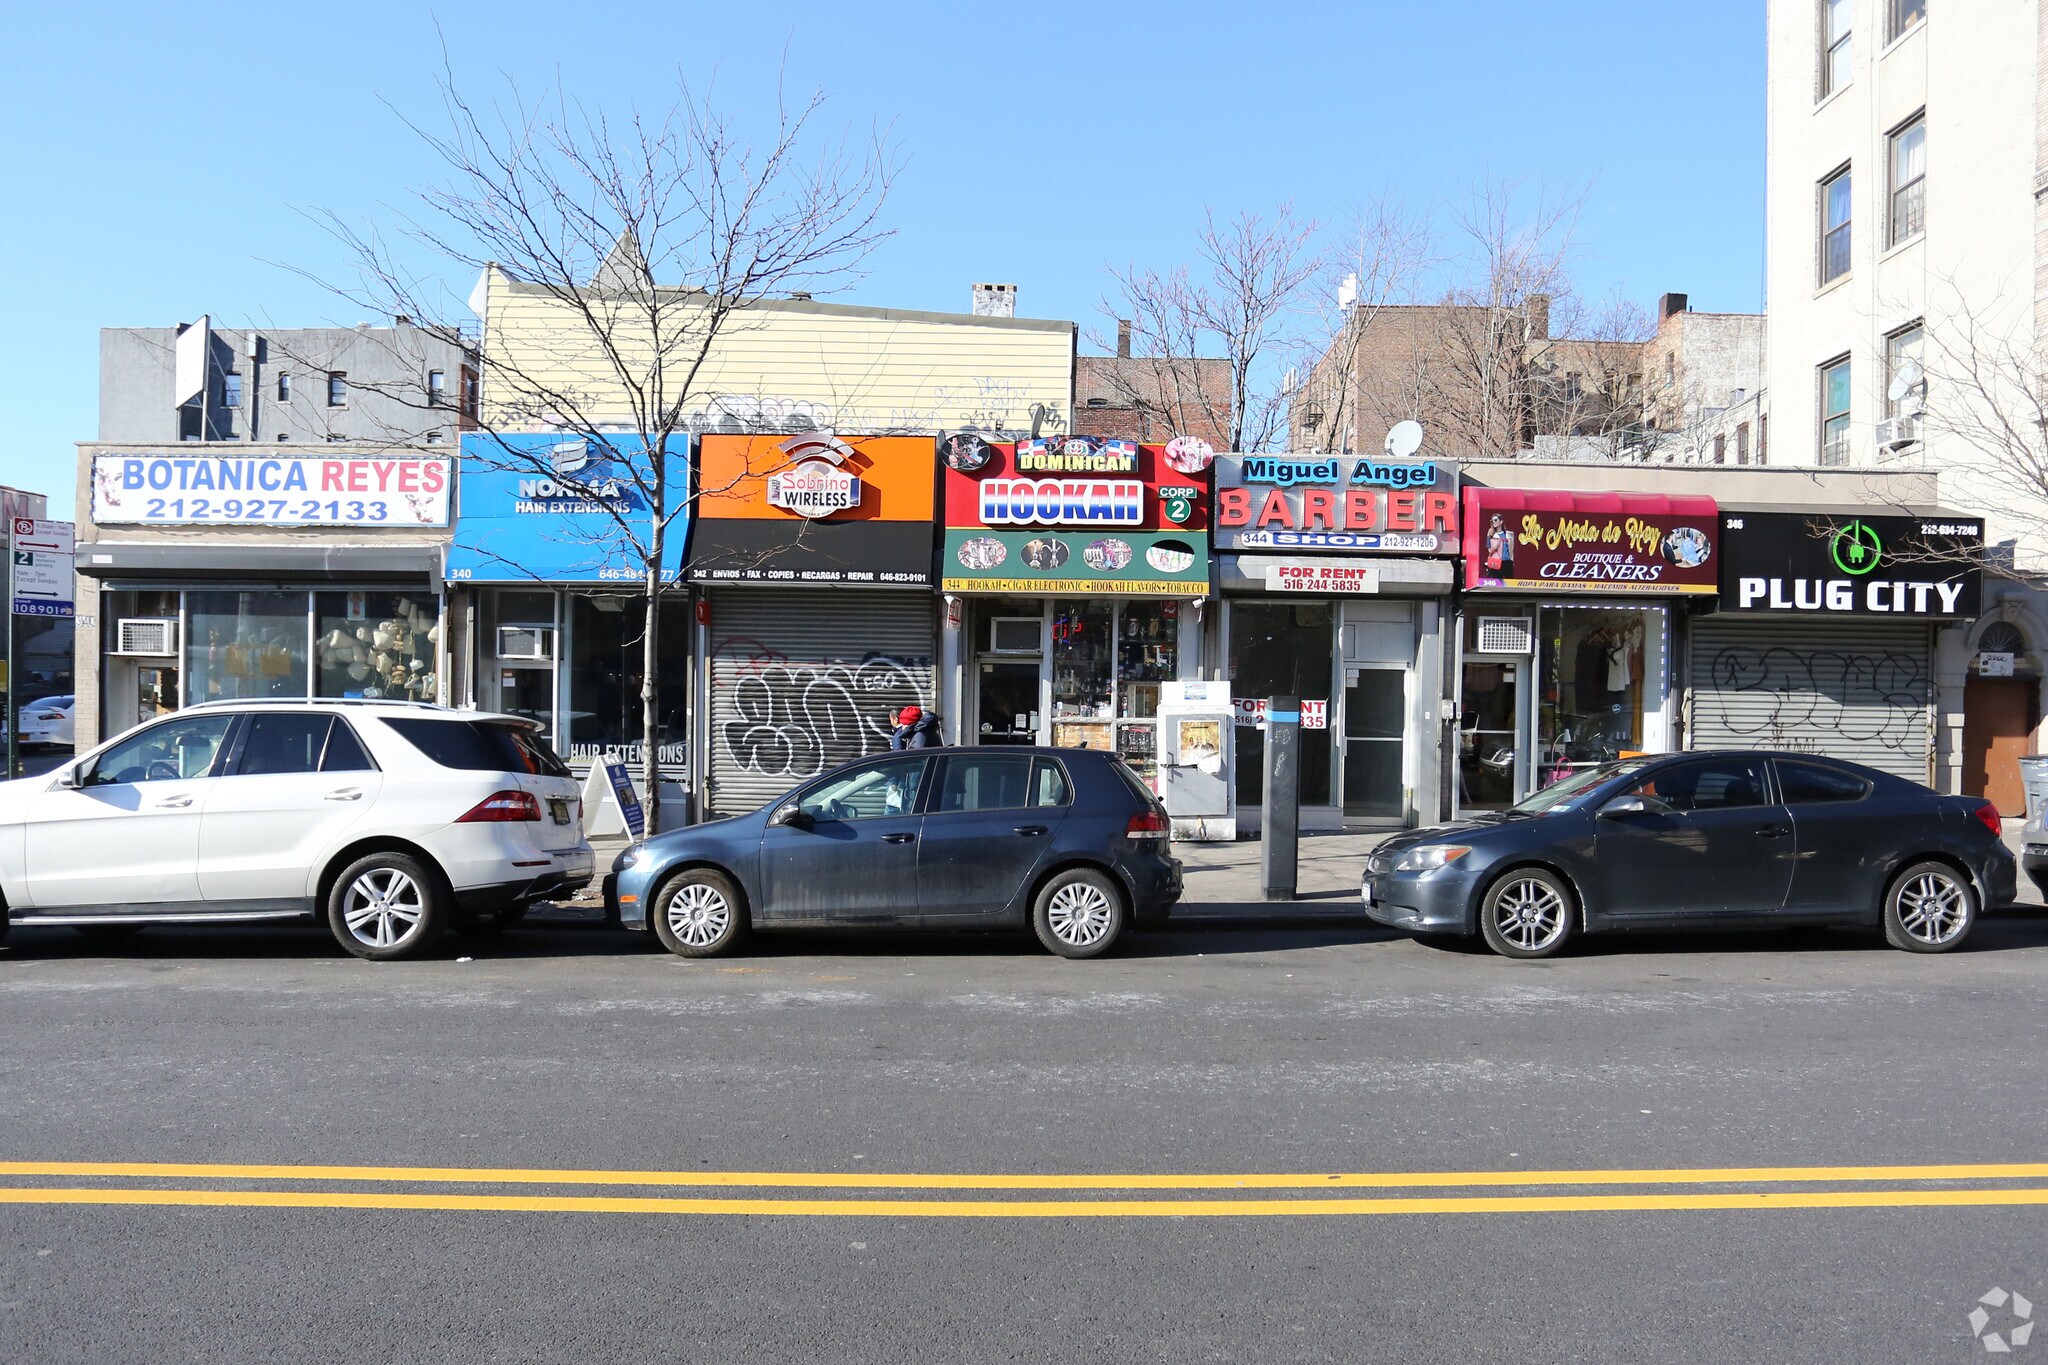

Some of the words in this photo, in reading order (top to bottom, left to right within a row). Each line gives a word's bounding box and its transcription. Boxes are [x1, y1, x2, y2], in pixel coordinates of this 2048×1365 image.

[1020, 455, 1131, 471] DOMINICAN
[122, 459, 308, 492] BOTANICA
[321, 460, 444, 493] REYES
[1243, 460, 1338, 481] Miguel
[1353, 462, 1435, 485] Angel
[782, 473, 849, 490] Sobrino
[784, 491, 847, 507] WIRELESS
[1159, 487, 1195, 498] CORP
[515, 501, 547, 513] HAIR
[550, 501, 631, 514] EXTENSIONS
[984, 483, 1138, 520] HOOKAH
[147, 498, 388, 521] 212-927-2133
[1170, 501, 1185, 518] 2
[1219, 488, 1458, 532] BARBER
[1727, 519, 1744, 529] 346
[1921, 524, 1978, 536] 212-634-7248
[1243, 533, 1268, 544] 344
[1275, 534, 1379, 546] SHOP
[1384, 537, 1434, 548] 212-927-1206
[1519, 514, 1544, 551] La
[1546, 517, 1600, 551] Moda
[1625, 517, 1661, 557] Hoy
[18, 552, 29, 565] 2
[1573, 553, 1623, 564] BOUTIQUE
[1625, 554, 1634, 564] &
[451, 569, 472, 579] 340
[599, 569, 675, 580] 646-484-77
[693, 569, 707, 578] 342
[712, 570, 740, 578] ENVIOS
[747, 570, 761, 578] FAX
[767, 570, 795, 579] COPIES
[801, 571, 840, 580] RECARGAS
[847, 571, 874, 580] REPAIR
[880, 572, 926, 582] 646-823-9101
[1279, 567, 1315, 579] FOR
[1320, 568, 1366, 579] RENT
[1540, 562, 1663, 580] CLEANERS
[948, 579, 960, 590] 344
[967, 579, 1001, 591] HOOKAH
[1091, 581, 1125, 592] HOOKAH
[1127, 581, 1161, 593] FLAVORS
[1166, 582, 1204, 594] TOBACCO
[1284, 579, 1361, 591] 516-244-5835
[1739, 578, 1854, 611] PLUG
[1866, 582, 1964, 614] CITY
[14, 604, 59, 614] 108901
[570, 743, 600, 760] HAIR
[606, 744, 684, 763] EXTENONS
